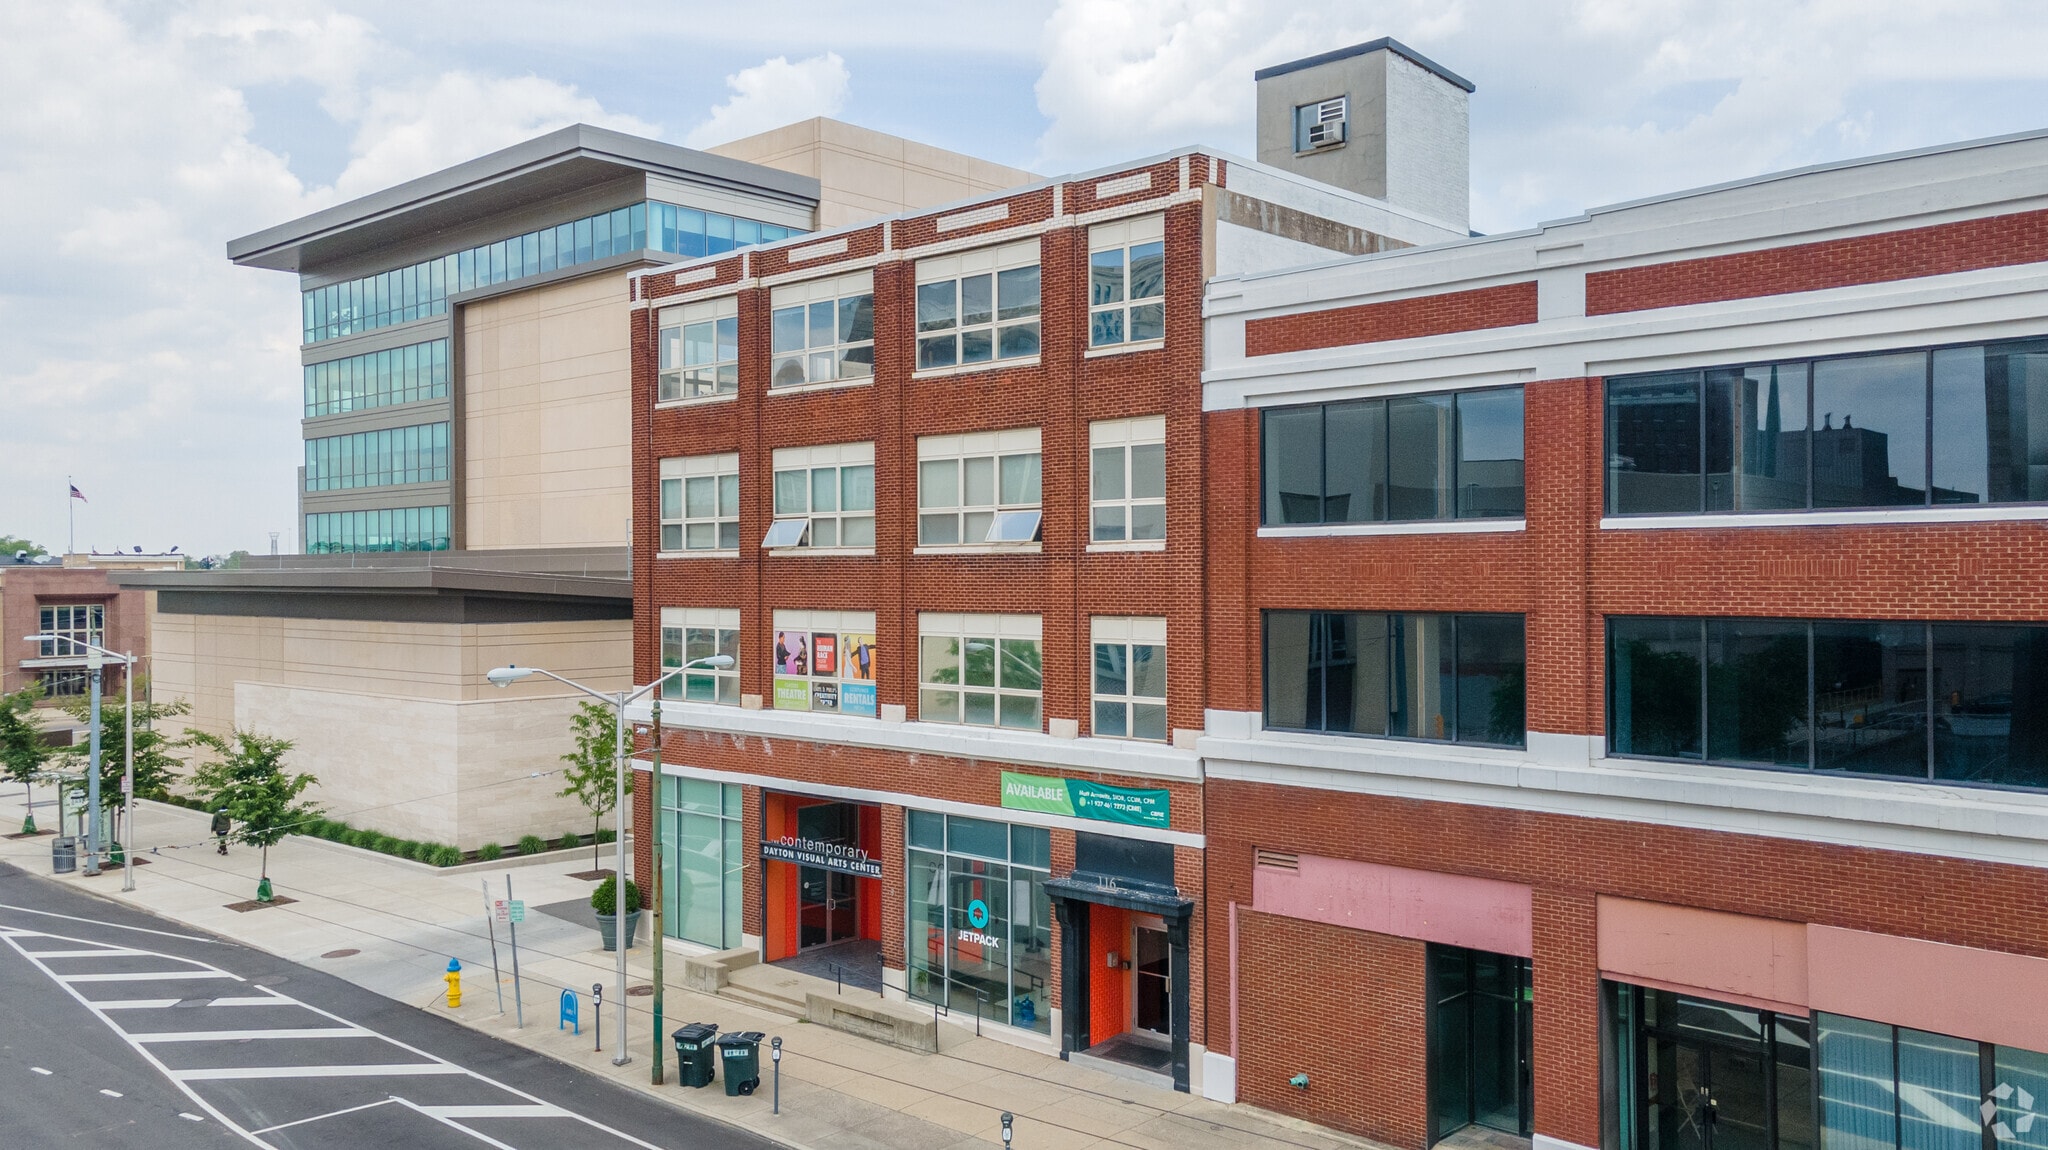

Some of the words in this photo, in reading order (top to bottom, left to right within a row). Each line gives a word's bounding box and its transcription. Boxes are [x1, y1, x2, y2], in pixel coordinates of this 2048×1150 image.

[777, 687, 806, 701] THEATRE
[844, 692, 875, 706] RENTALS
[1006, 783, 1063, 801] AVAILABLE
[780, 835, 869, 863] contemporary
[763, 846, 794, 859] DAYTON
[796, 851, 825, 865] VISUAL
[827, 857, 848, 869] ARTS
[850, 861, 880, 874] CENTER
[1098, 876, 1116, 889] 116
[958, 930, 999, 949] JETPACK
